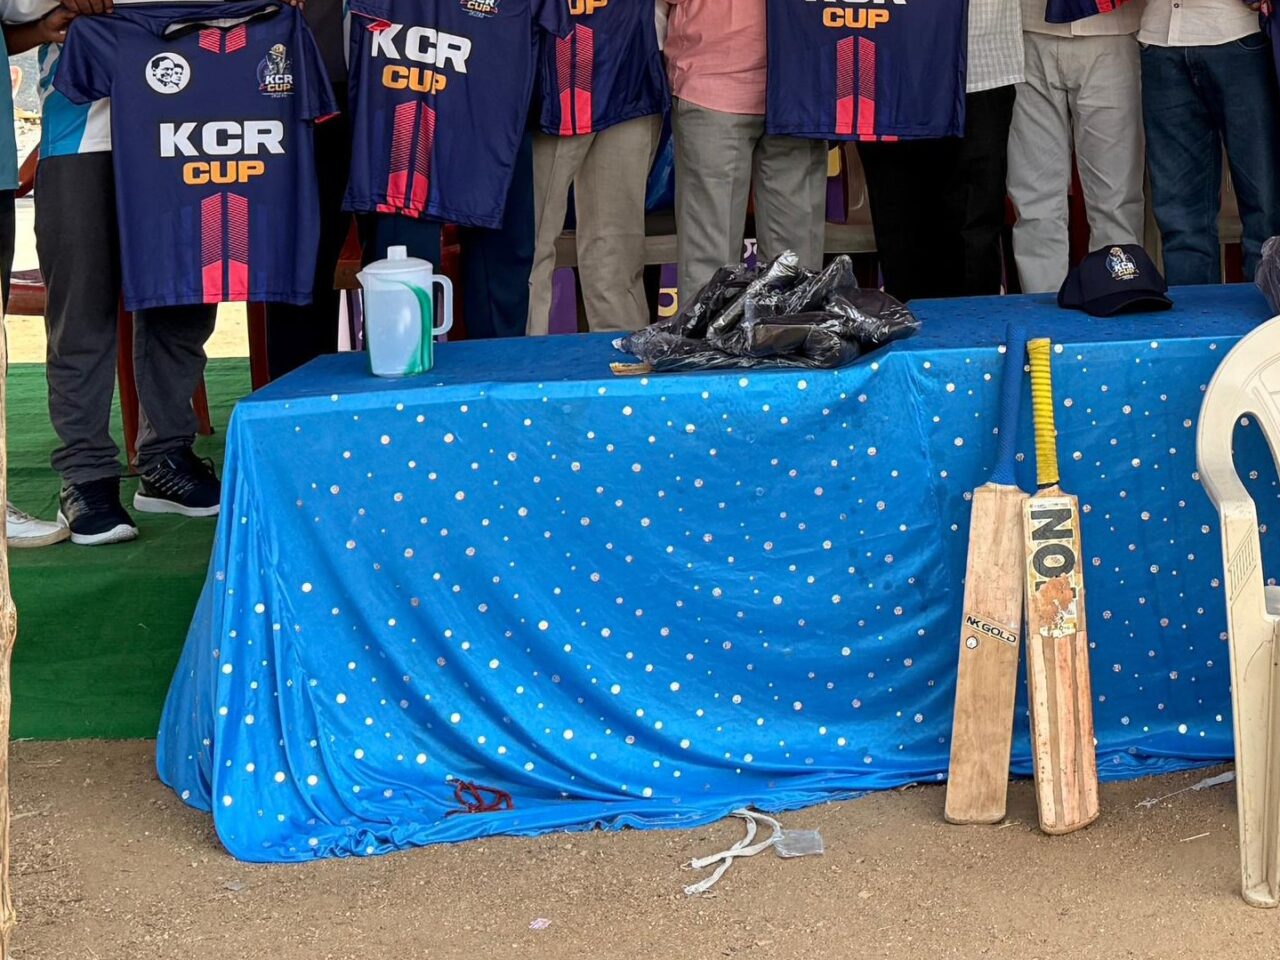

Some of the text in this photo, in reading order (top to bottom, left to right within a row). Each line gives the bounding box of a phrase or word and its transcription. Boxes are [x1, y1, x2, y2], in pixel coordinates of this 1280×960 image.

[466, 0, 492, 12] CUP
[822, 7, 890, 29] CUP
[371, 24, 472, 74] KCR
[265, 74, 293, 84] KCR
[267, 83, 291, 92] CUP
[382, 64, 447, 96] CUP
[160, 120, 286, 157] KCR
[183, 160, 265, 185] CUP
[1114, 261, 1135, 272] KCR
[966, 616, 1017, 643] NK GOLD
